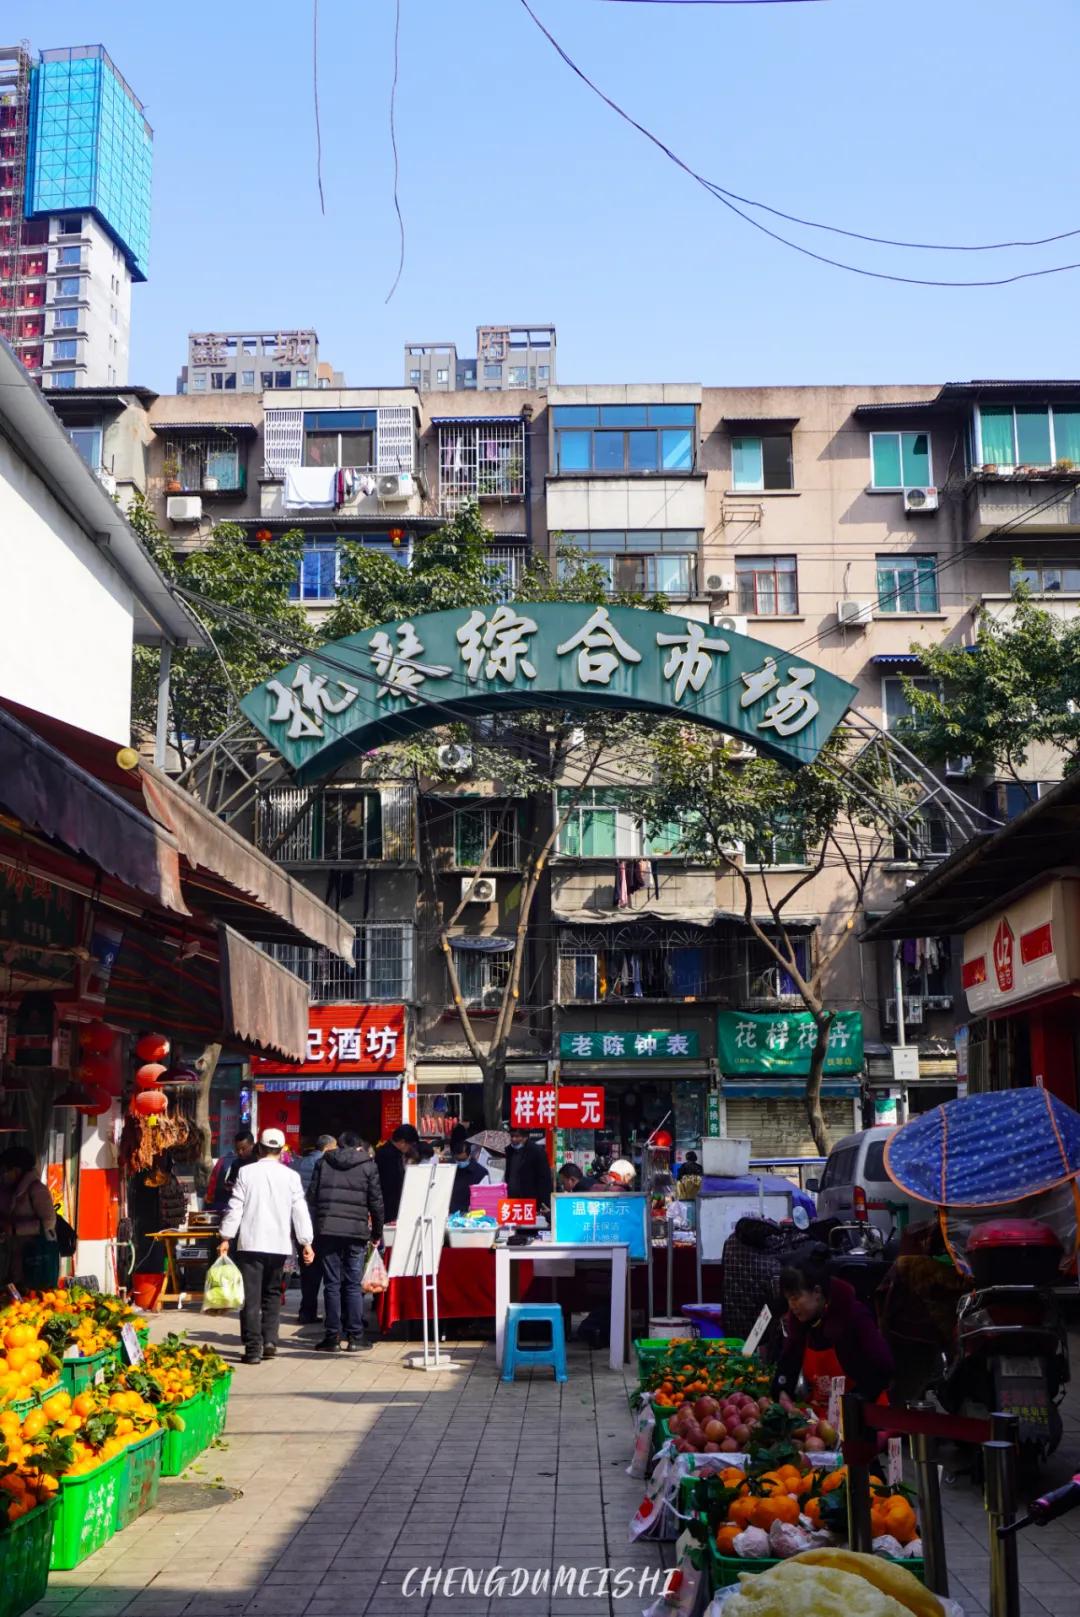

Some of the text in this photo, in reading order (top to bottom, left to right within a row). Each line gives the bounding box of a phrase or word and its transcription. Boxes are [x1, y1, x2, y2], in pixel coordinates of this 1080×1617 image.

[266, 605, 820, 739] 抚琴综合市场
[571, 1033, 689, 1056] 老陈钟表
[735, 1020, 850, 1050] 花样花卉
[514, 1090, 601, 1124] 样样一元
[500, 1202, 535, 1222] 多元区
[572, 1201, 630, 1216] 温馨提示
